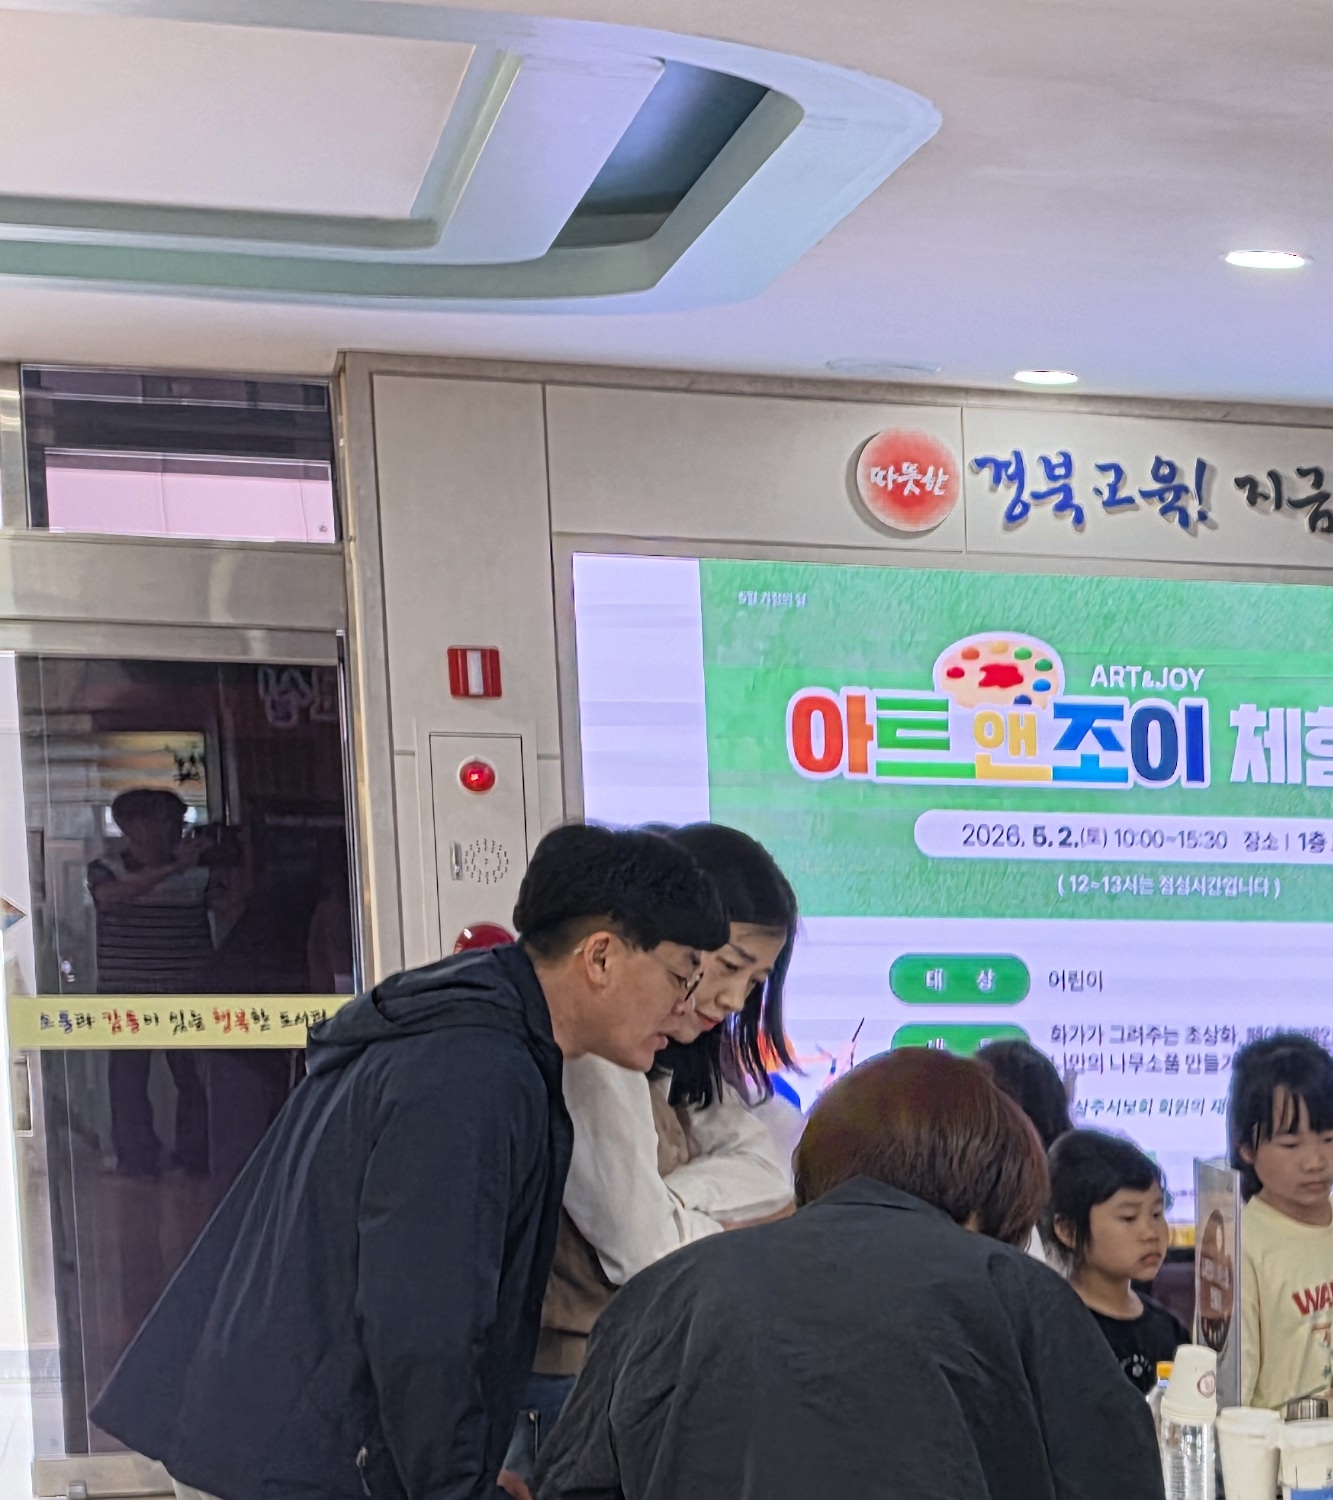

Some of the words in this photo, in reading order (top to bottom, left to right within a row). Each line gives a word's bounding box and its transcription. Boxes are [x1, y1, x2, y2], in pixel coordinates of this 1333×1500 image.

[870, 463, 949, 498] 따뜻한
[1091, 664, 1206, 692] ART&JOY
[790, 694, 1208, 784] 아트앤조이
[962, 823, 1025, 847] 2026.
[1244, 831, 1279, 852] 장소
[1109, 1025, 1179, 1047] 그려주는
